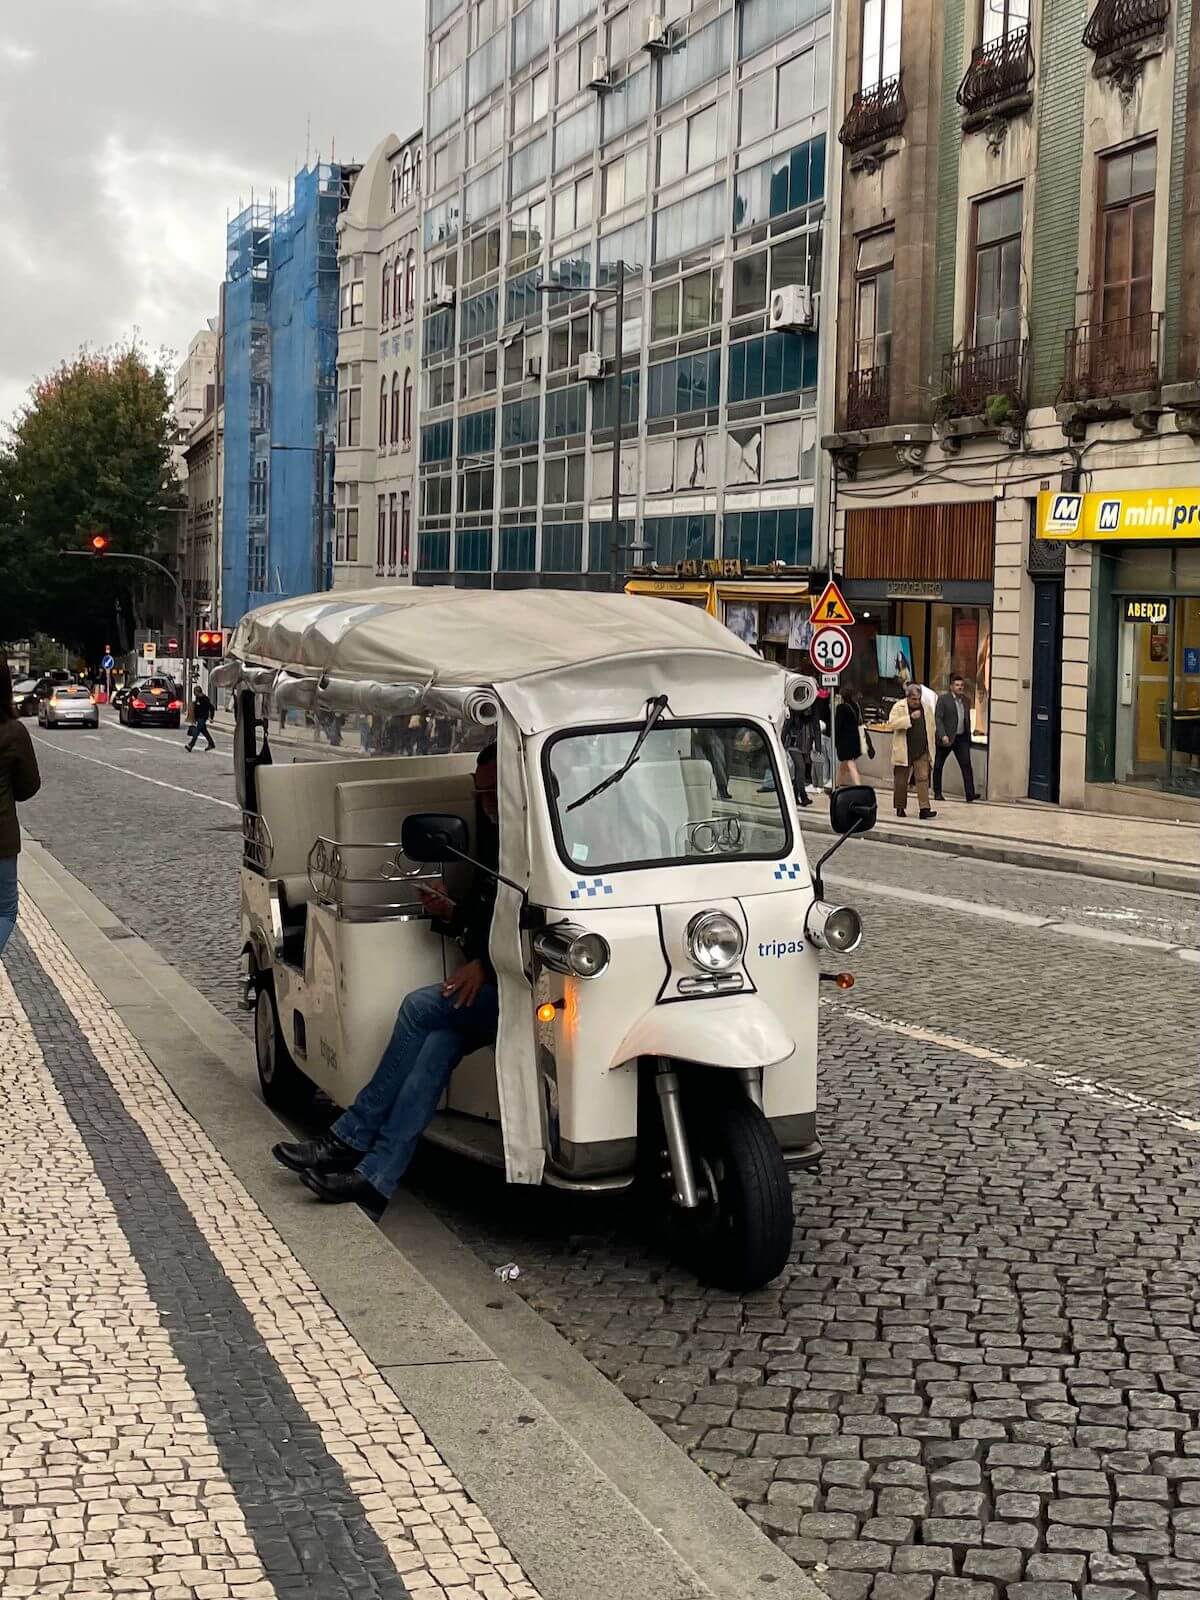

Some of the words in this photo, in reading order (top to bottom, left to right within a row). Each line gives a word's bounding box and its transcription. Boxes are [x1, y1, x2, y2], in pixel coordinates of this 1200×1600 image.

[1054, 498, 1079, 519] M
[1100, 504, 1119, 528] M
[1124, 497, 1200, 530] minipr
[1127, 602, 1167, 618] ABERTO
[817, 641, 844, 658] 30
[758, 939, 804, 959] tripas
